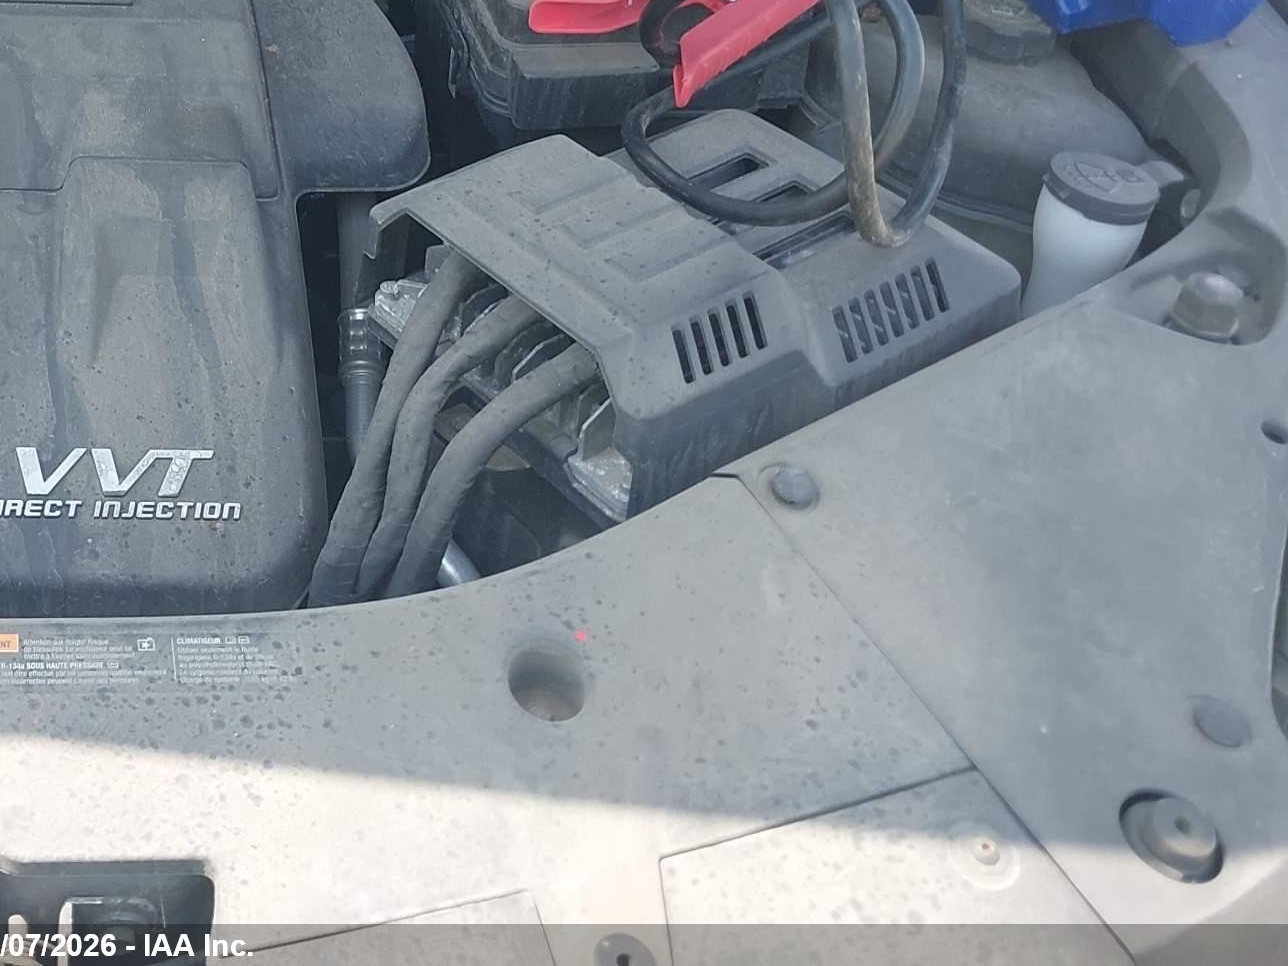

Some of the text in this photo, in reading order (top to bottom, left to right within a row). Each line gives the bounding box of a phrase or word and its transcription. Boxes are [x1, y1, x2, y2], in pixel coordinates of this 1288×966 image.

[14, 446, 215, 498] VVT
[93, 500, 242, 521] INJECTION
[176, 637, 221, 645] CLIMATISEUR
[26, 662, 45, 670] SOUS
[46, 662, 68, 670] HAUTE
